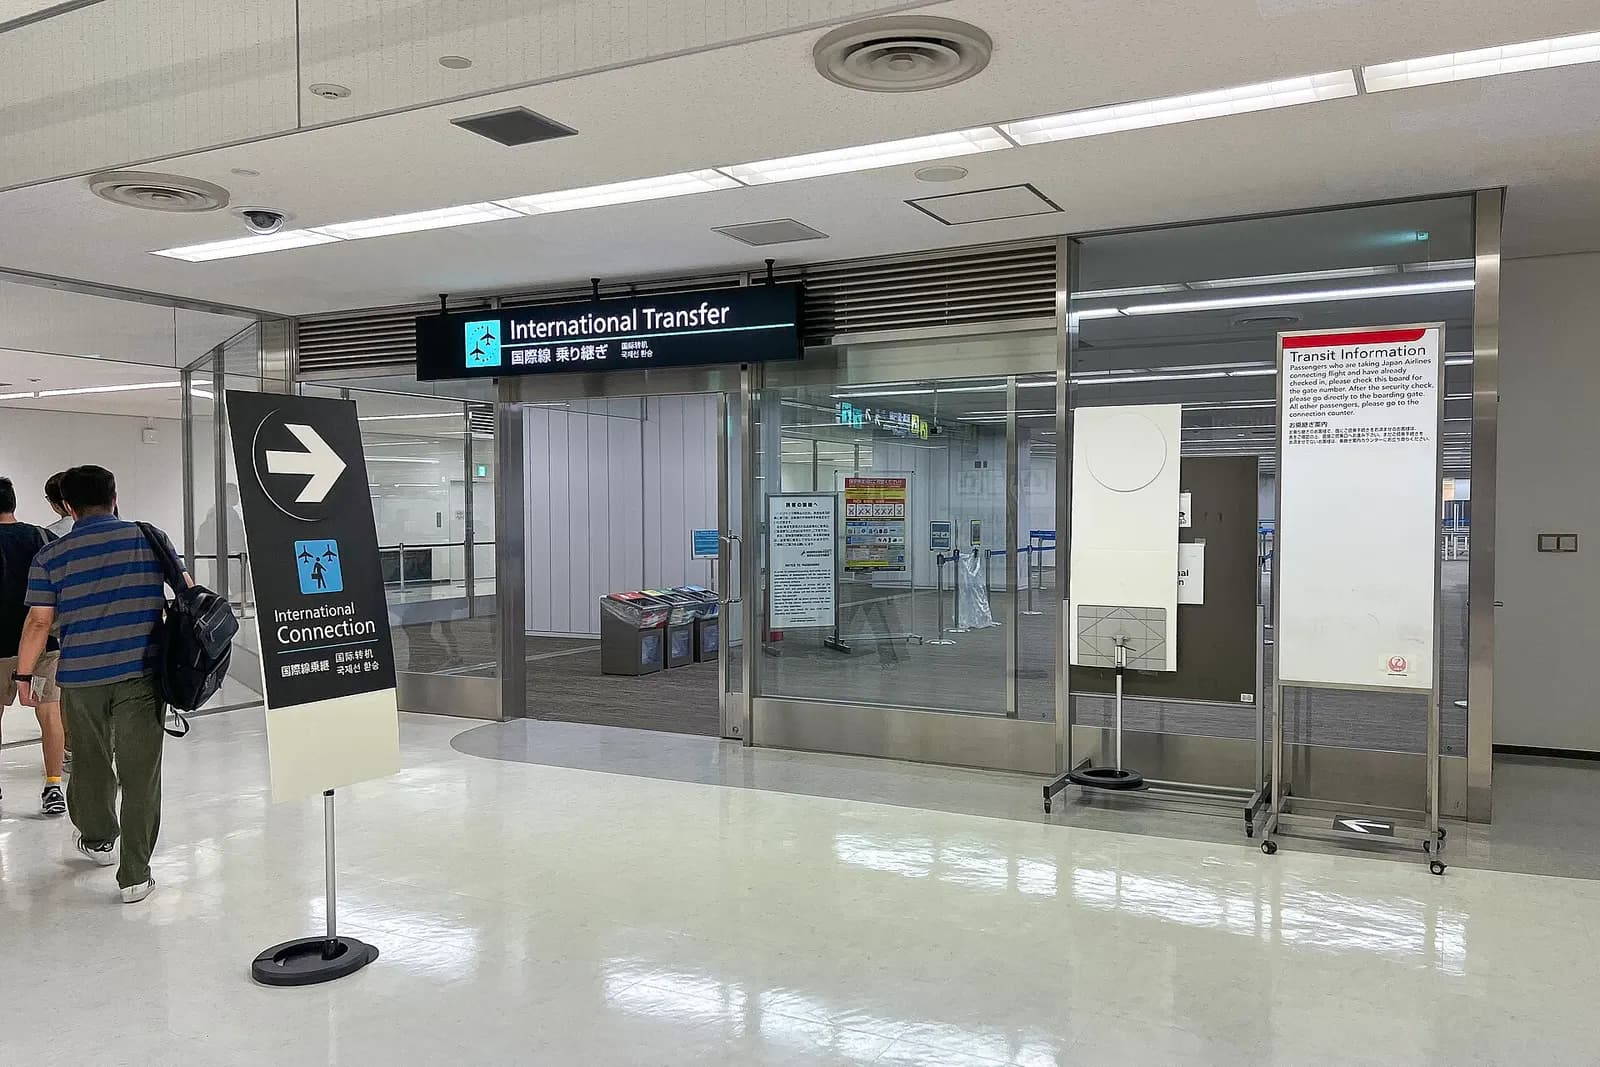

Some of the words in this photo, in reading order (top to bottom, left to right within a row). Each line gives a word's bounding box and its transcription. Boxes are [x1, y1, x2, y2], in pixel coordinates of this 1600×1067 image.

[510, 308, 637, 340] International
[642, 302, 730, 330] Transfer
[511, 348, 551, 365] 国際線
[555, 343, 609, 363] 乗り継ぎ
[1290, 350, 1336, 362] Transit
[1342, 345, 1426, 360] Information
[1328, 370, 1346, 378] flight
[1329, 378, 1351, 386] please
[1382, 383, 1409, 391] security
[1320, 402, 1360, 410] passengers,
[274, 602, 355, 622] International
[277, 618, 376, 644] Connection
[336, 649, 373, 663] 国际转机
